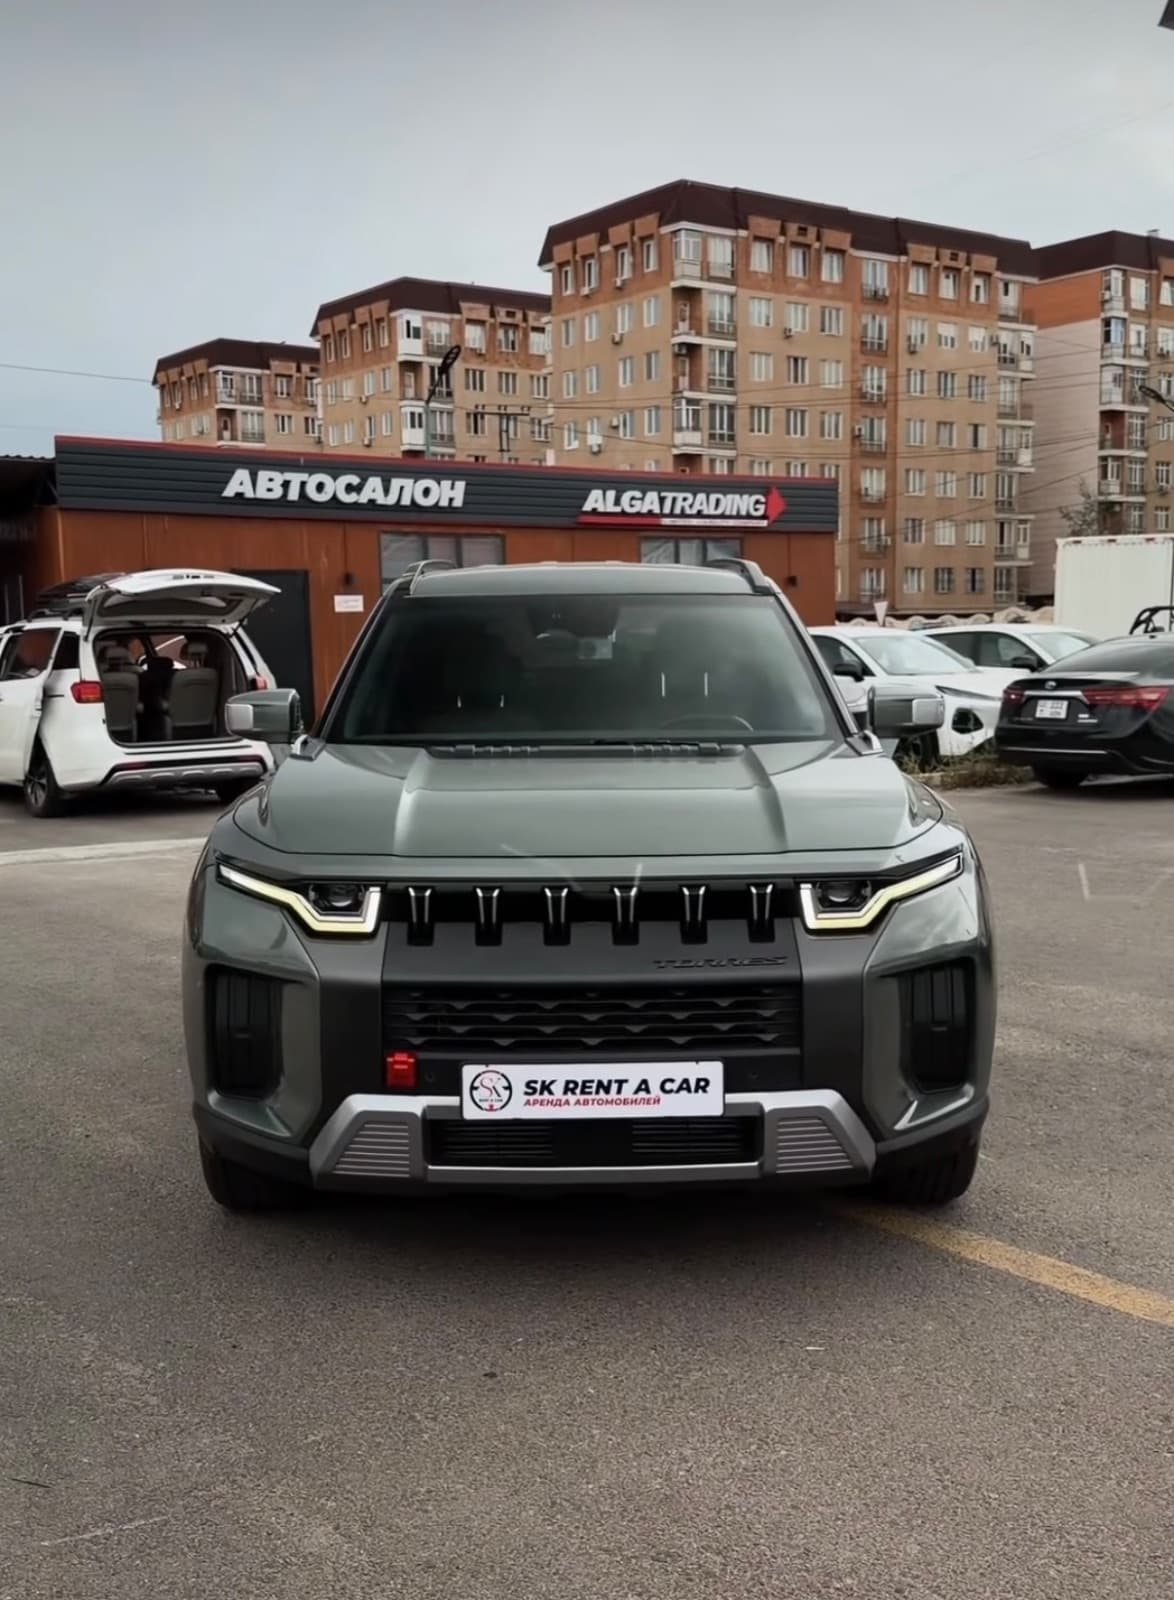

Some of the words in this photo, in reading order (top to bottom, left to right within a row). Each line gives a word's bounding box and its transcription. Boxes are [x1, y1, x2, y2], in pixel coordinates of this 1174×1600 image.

[221, 468, 467, 507] АВТОСАЛОН
[581, 489, 767, 516] ALGATRADING
[653, 956, 788, 969] TORRES
[523, 1079, 557, 1096] SK
[562, 1079, 628, 1096] RENT
[633, 1078, 656, 1095] A
[659, 1077, 710, 1095] CAR
[523, 1098, 570, 1107] АРЕНДА
[573, 1096, 661, 1107] АВТОМОБИЛЕЙ
